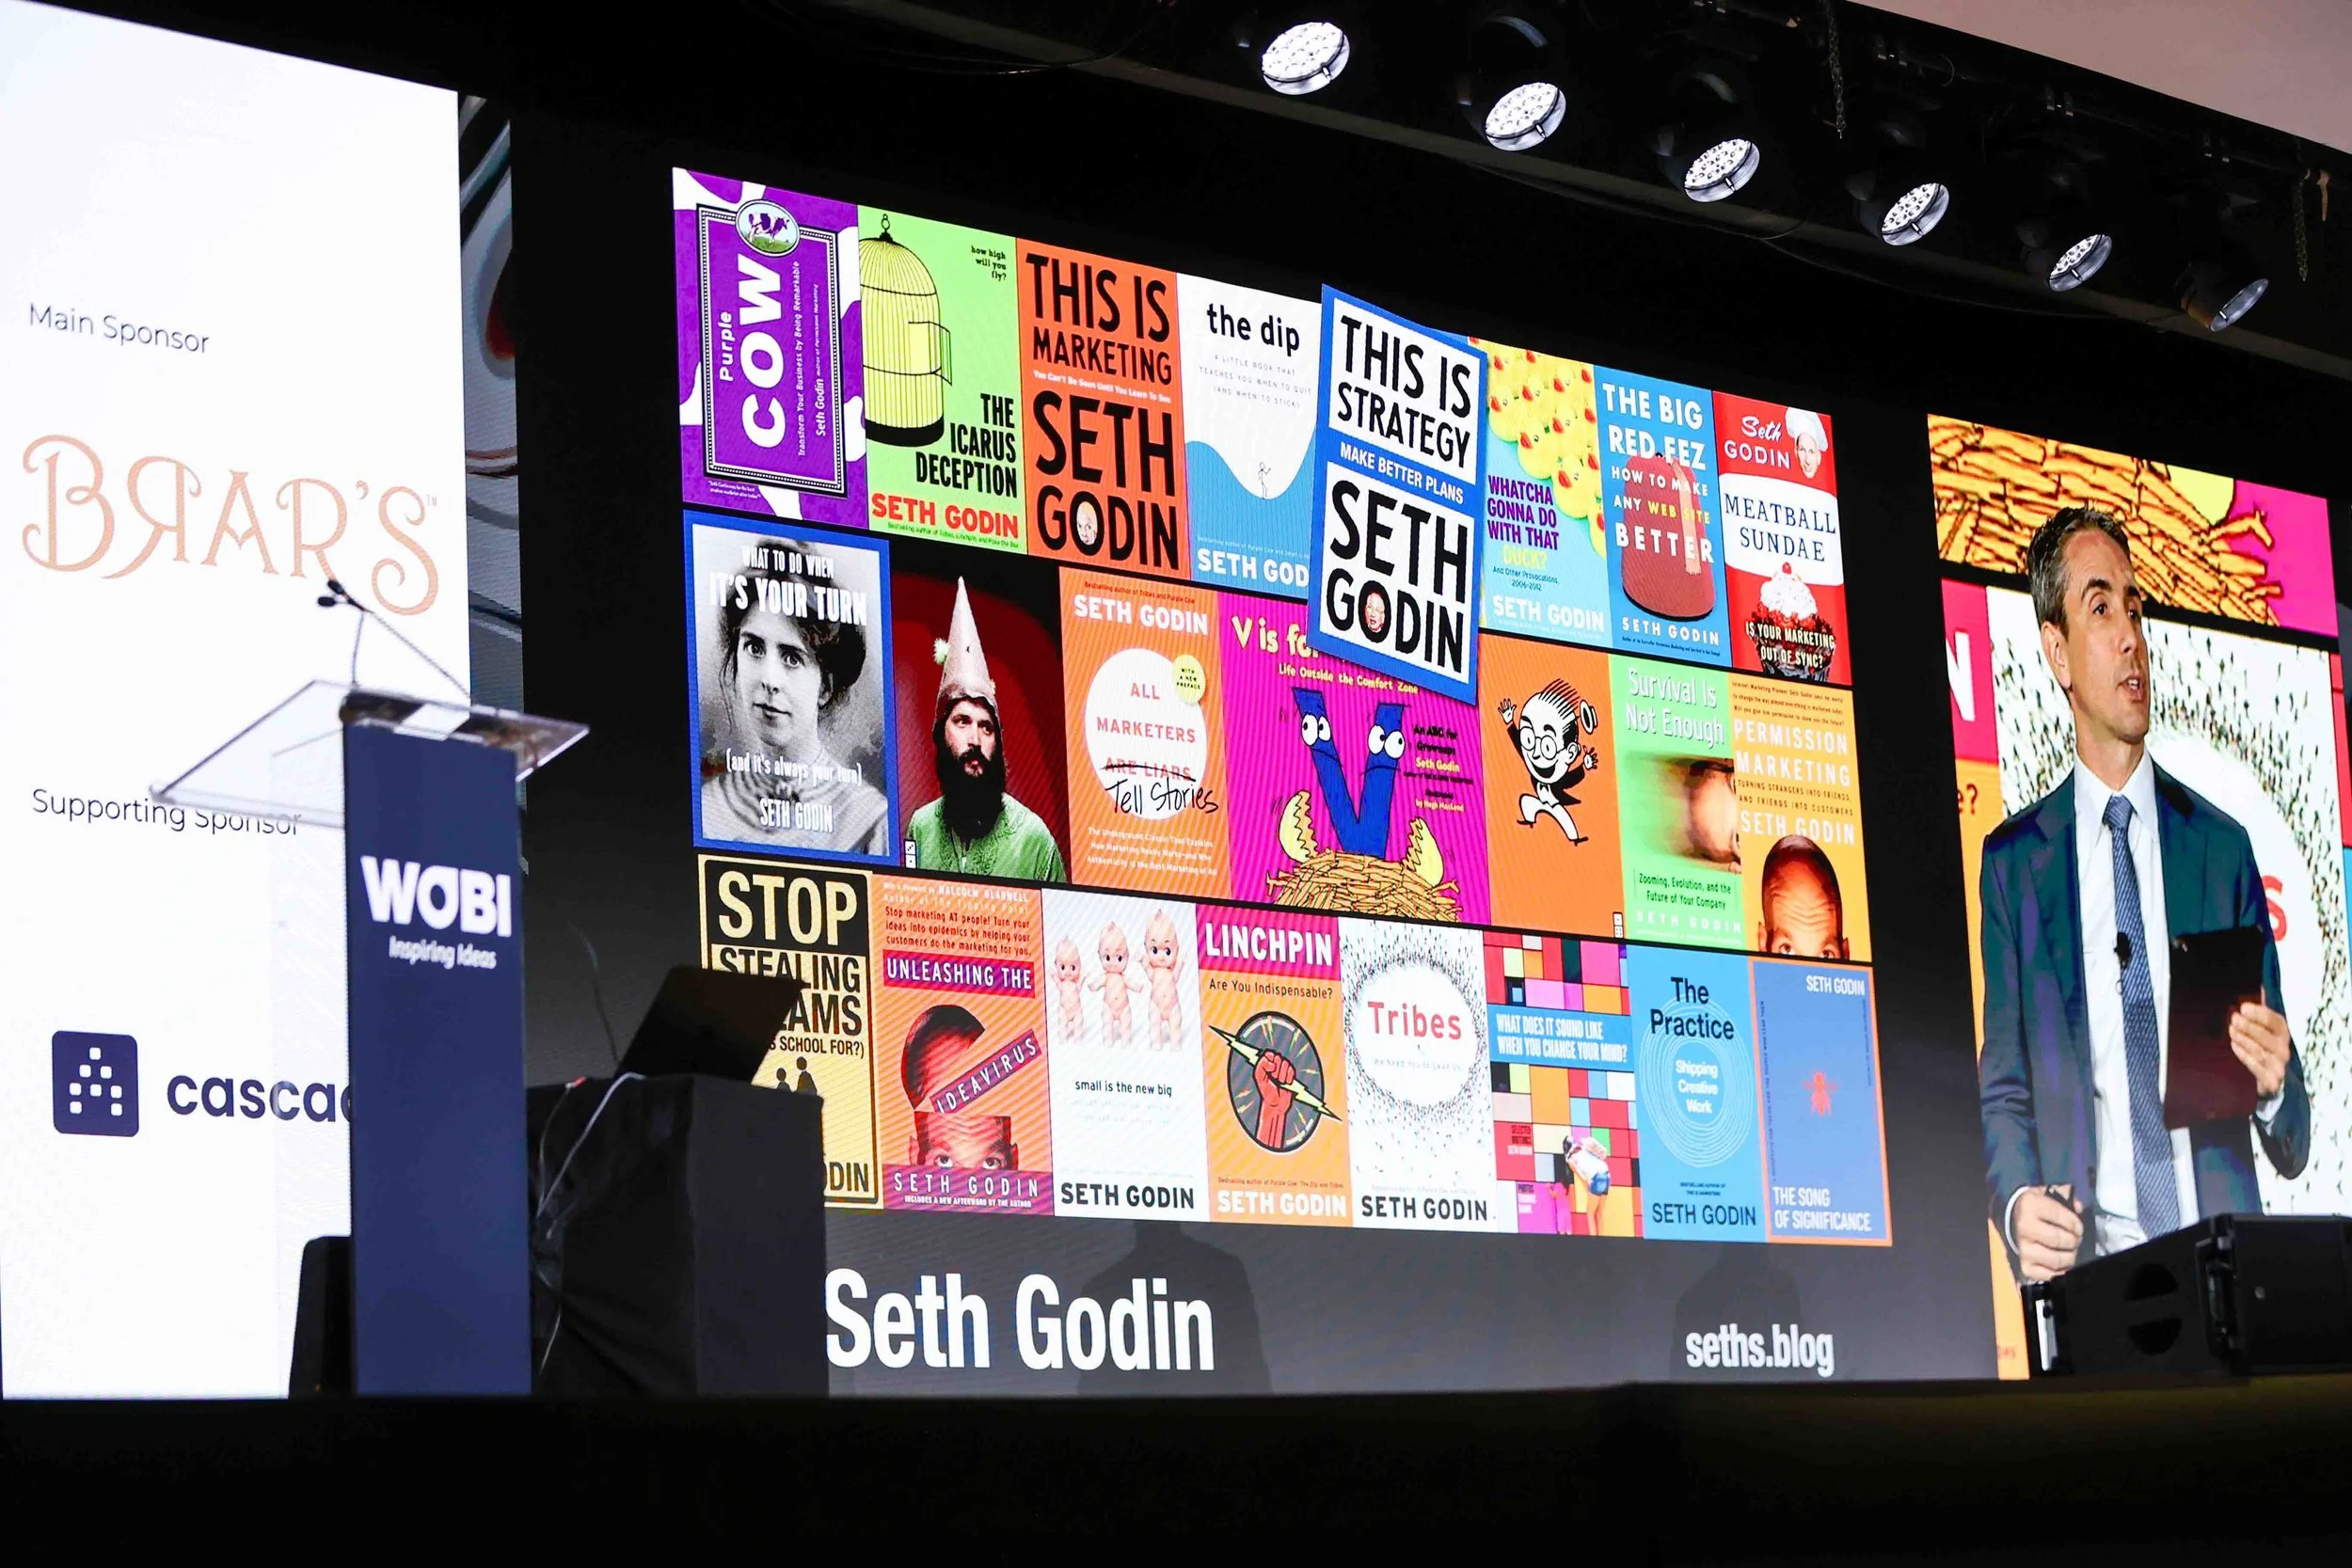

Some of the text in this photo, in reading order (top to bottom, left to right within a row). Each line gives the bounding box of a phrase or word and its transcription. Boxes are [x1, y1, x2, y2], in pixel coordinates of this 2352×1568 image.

[971, 245, 1006, 261] how high
[976, 258, 1007, 271] will you
[992, 271, 1007, 281] fly?
[1025, 252, 1170, 342] THIS IS
[29, 303, 209, 354] Main Sponsor
[720, 311, 733, 381] Purple
[1207, 303, 1299, 357] the dip
[1033, 325, 1172, 385] MARKETING
[1341, 315, 1471, 418] THIS IS
[814, 378, 825, 436] Seth Godin
[980, 393, 1014, 428] THE
[1602, 383, 1703, 430] THE BIG
[1337, 381, 1470, 469] STRATEGY
[1740, 416, 1782, 442] Seth
[950, 423, 1016, 463] ICARUS
[1034, 389, 1175, 497] SETH
[1608, 424, 1707, 470] RED FEZ
[1724, 439, 1791, 469] GODIN
[915, 452, 1017, 498] DECEPTION
[1340, 441, 1464, 504] MAKE BETTER PLANS
[1612, 467, 1708, 497] HOW TO MAKE
[1488, 475, 1554, 506] WHATCHA
[1613, 495, 1642, 511] ANY
[1647, 500, 1677, 518] WEB
[871, 493, 1018, 539] SETH GODIN
[1037, 484, 1179, 570] GODIN
[1487, 498, 1557, 529] GONNA DO
[1724, 493, 1836, 534] MEATBALL
[1330, 479, 1469, 605] SETH
[1487, 520, 1559, 550] WITH THAT
[1615, 522, 1714, 563] BETTER
[1740, 527, 1825, 562] SUNDAE
[741, 545, 834, 578] WHAT TO DO WHEN
[1198, 547, 1257, 579] SETH
[709, 571, 867, 626] IT'S YOUR TURN
[1073, 594, 1208, 636] SETH GODIN
[1492, 594, 1542, 623] SETH
[1548, 604, 1604, 632] GODIN
[1232, 615, 1279, 654] V is
[1327, 567, 1465, 675] GODIN
[1622, 617, 1661, 636] SETH
[1668, 625, 1719, 645] GODIN
[1746, 621, 1835, 650] IS YOUR MARKETING
[1760, 642, 1823, 669] OUT OF SYNC?
[1131, 683, 1160, 700] ALL
[1279, 663, 1418, 694] Life Outside the Comfort Zone
[1629, 667, 1717, 708] Survival Is
[1097, 717, 1196, 743] MARKETERS
[1626, 703, 1724, 750] Not Enough
[1734, 719, 1848, 755] PERMISSION
[1736, 751, 1851, 787] MARKETING
[33, 789, 301, 835] Supporting Sponsor
[1105, 777, 1218, 815] Tell Stories
[760, 798, 834, 832] SETH GODIN
[1740, 810, 1855, 845] SETH GODIN
[360, 856, 512, 937] WOBI
[718, 870, 857, 946] STOP
[389, 936, 497, 969] Inspiring Ideas
[1205, 922, 1333, 966] LINCHPIN
[720, 947, 861, 993] STEALING
[887, 958, 1032, 990] UNLEASHING THE
[1806, 975, 1866, 995] SETH GODIN
[1209, 978, 1333, 1000] Are You Indispensable?
[1671, 976, 1708, 1005] The
[1368, 1001, 1461, 1040] Tribes
[1496, 1013, 1603, 1039] WHAT DOES IT SOUND LIKE
[1650, 1009, 1734, 1039] Practice
[780, 1037, 827, 1053] SCHOOL
[831, 1039, 864, 1059] FOR?)
[1498, 1036, 1628, 1063] WHEN YOU CHANGE YOUR MIND?
[937, 1038, 1037, 1113] IDEAVIRUS
[1676, 1060, 1718, 1078] Shipping
[1075, 1080, 1171, 1098] small is the new big
[1678, 1080, 1718, 1095] Creative
[1686, 1099, 1712, 1115] Work
[895, 1173, 1038, 1197] SETH GODIN
[1061, 1182, 1194, 1210] SETH GODIN
[1772, 1186, 1830, 1207] THE SONG
[1217, 1190, 1346, 1216] SETH GODIN
[1362, 1196, 1487, 1221] SETH GODIN
[1652, 1203, 1756, 1226] SETH GODIN
[1774, 1210, 1871, 1232] OF SIGNIFICANCE
[825, 1268, 1214, 1371] Seth Godin
[1686, 1323, 1835, 1378] seths.blog
